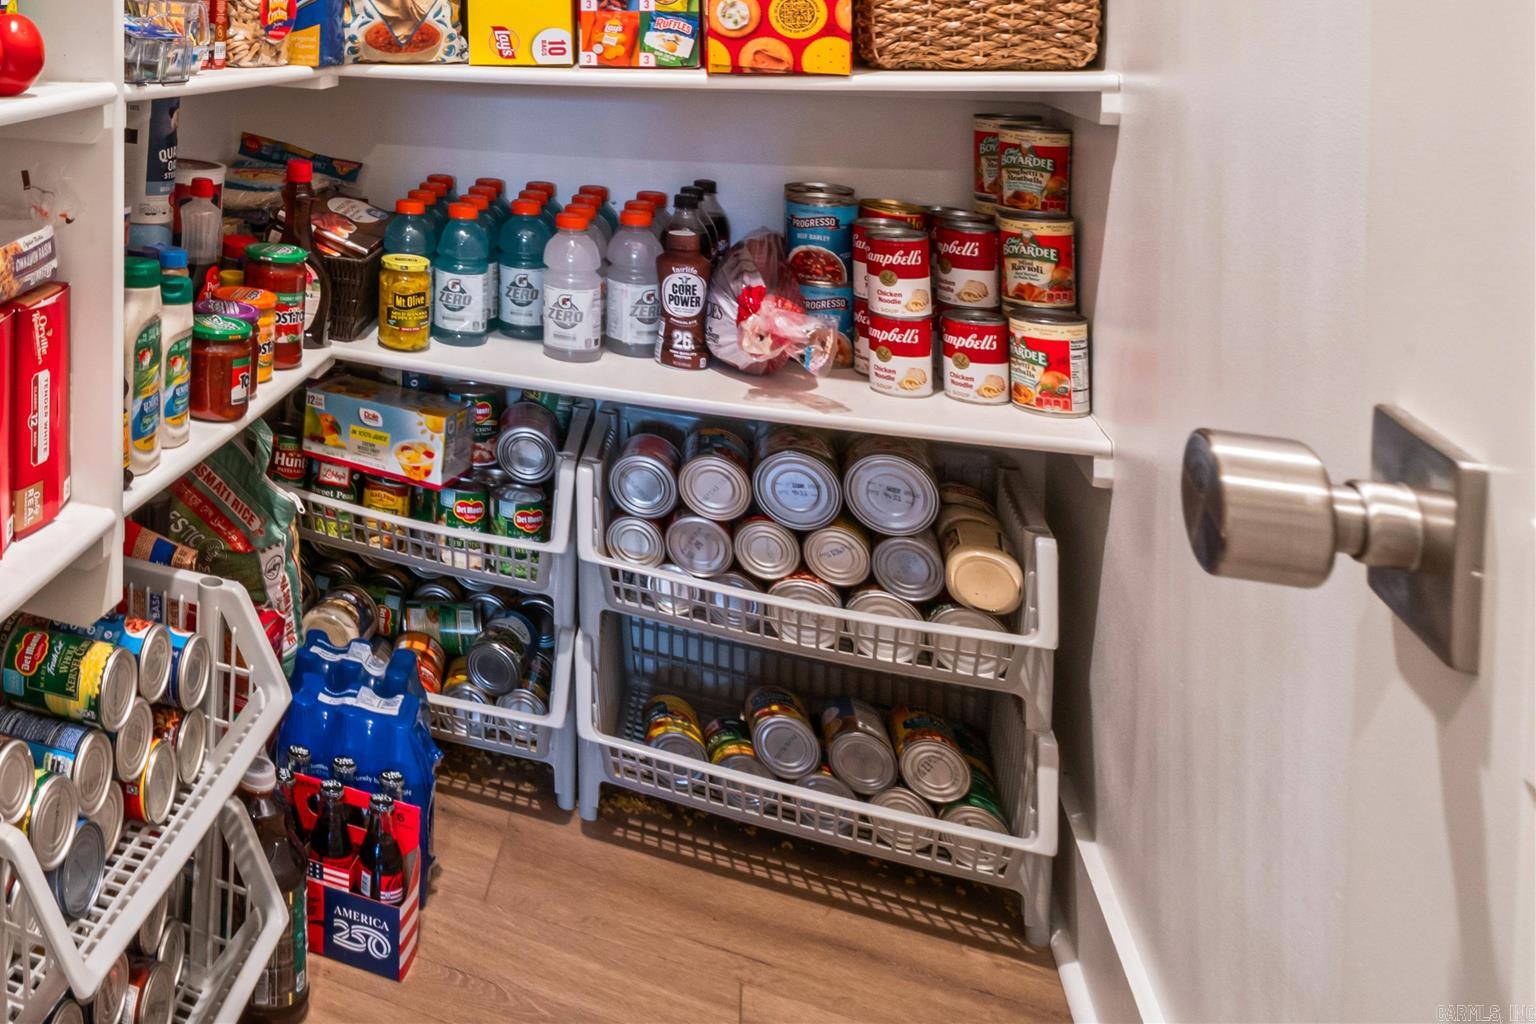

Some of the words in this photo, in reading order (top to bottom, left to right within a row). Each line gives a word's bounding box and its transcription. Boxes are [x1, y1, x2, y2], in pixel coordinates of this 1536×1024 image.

[585, 0, 592, 9] 3
[643, 0, 650, 9] 3
[654, 18, 692, 34] RUFFLES
[495, 30, 514, 58] Lay's
[548, 40, 567, 57] 10
[585, 54, 592, 64] 3
[643, 55, 650, 65] 3
[1001, 154, 1055, 171] BOYARDEE
[792, 217, 836, 228] PROGRESSO
[867, 250, 921, 267] ampbell's
[1005, 244, 1058, 261] BOYARDEE
[1011, 263, 1043, 274] Ravioli
[506, 287, 539, 301] ZERO
[672, 284, 697, 296] CORE
[876, 289, 903, 298] Chicken
[395, 294, 406, 305] Mt.
[407, 293, 425, 306] Olive
[439, 290, 472, 306] ZERO
[668, 295, 701, 308] POWER
[803, 299, 846, 310] ROGRESSO
[878, 296, 902, 305] Noodle
[548, 309, 584, 323] ZERO
[38, 314, 49, 357] Orville
[868, 328, 919, 344] ampbell's
[873, 364, 896, 375] Chicken
[949, 371, 975, 382] Chicken
[950, 378, 974, 389] Noodle
[307, 394, 315, 405] 12
[363, 410, 379, 421] Dole
[274, 450, 306, 471] Hunt
[26, 487, 34, 524] REAL
[32, 492, 41, 515] Only
[231, 497, 255, 526] RICE
[59, 645, 77, 674] WHOLE
[66, 661, 81, 693] KERNEL
[397, 813, 405, 822] 6
[333, 906, 389, 933] AMERICA
[332, 918, 391, 960] 250
